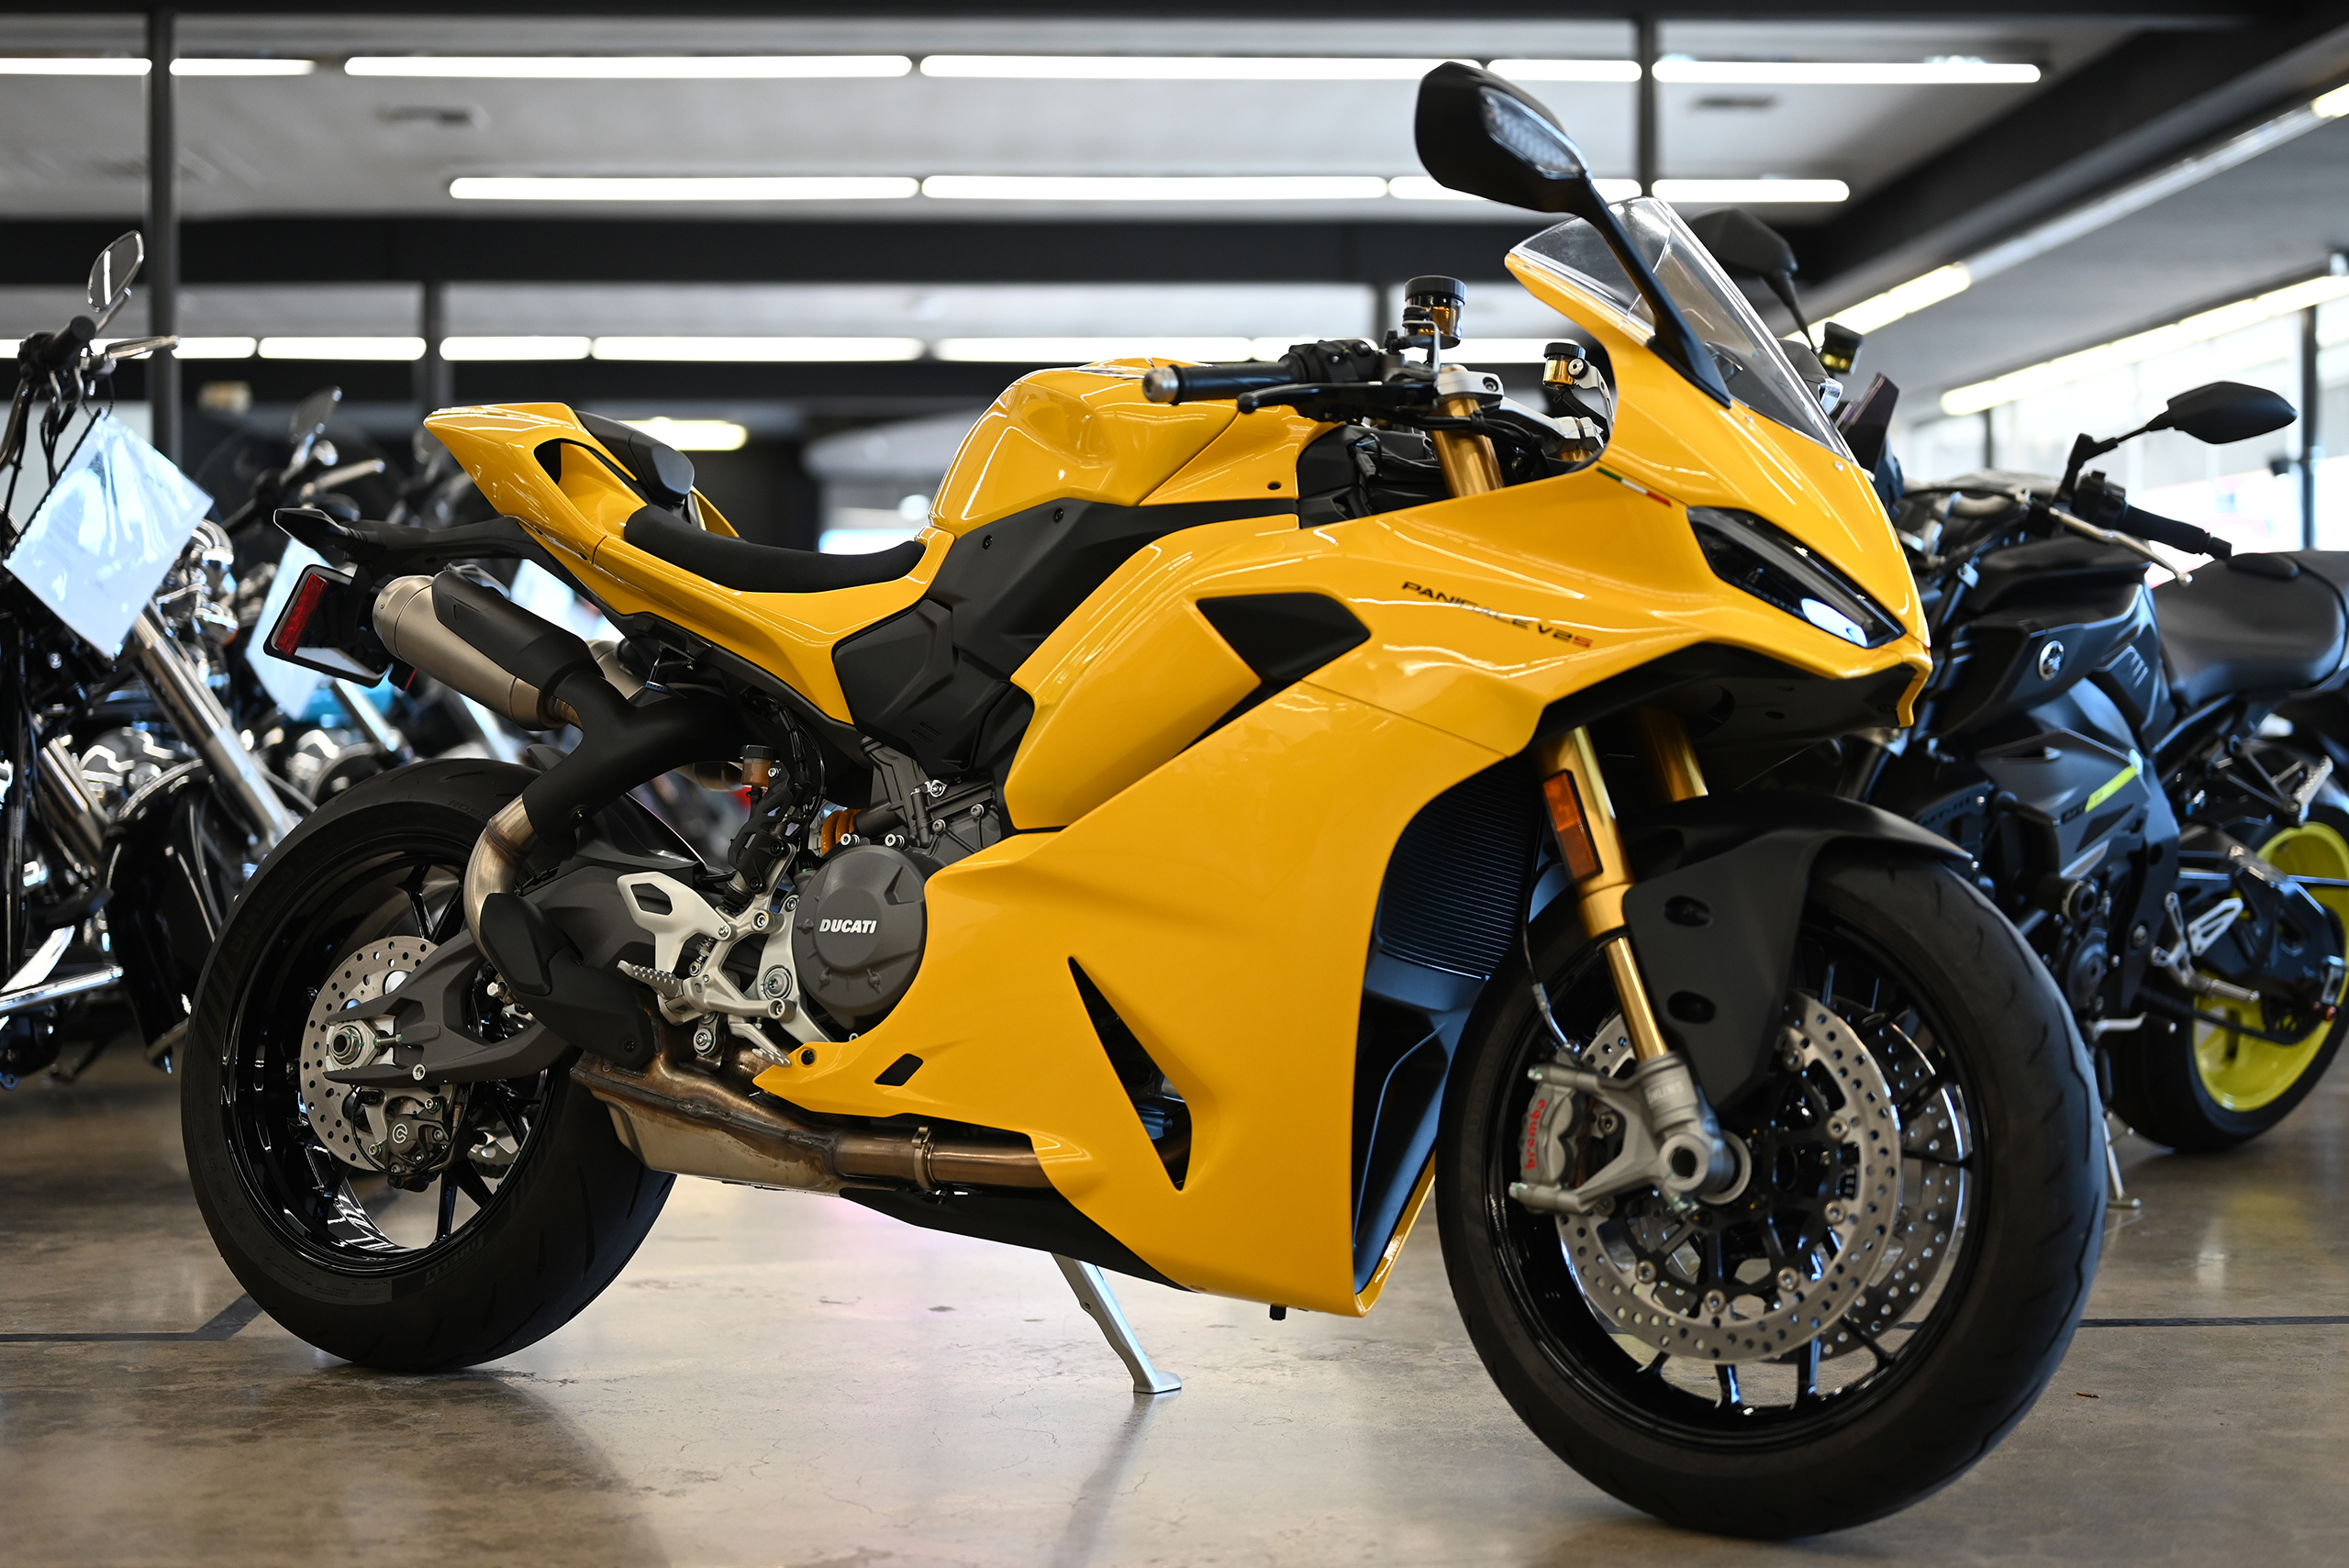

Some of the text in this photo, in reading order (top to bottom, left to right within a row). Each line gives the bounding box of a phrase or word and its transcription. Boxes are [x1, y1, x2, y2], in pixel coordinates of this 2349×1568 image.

[818, 918, 877, 934] DUCATI
[1525, 1099, 1546, 1170] brembo
[424, 1233, 484, 1286] PIRELLI
